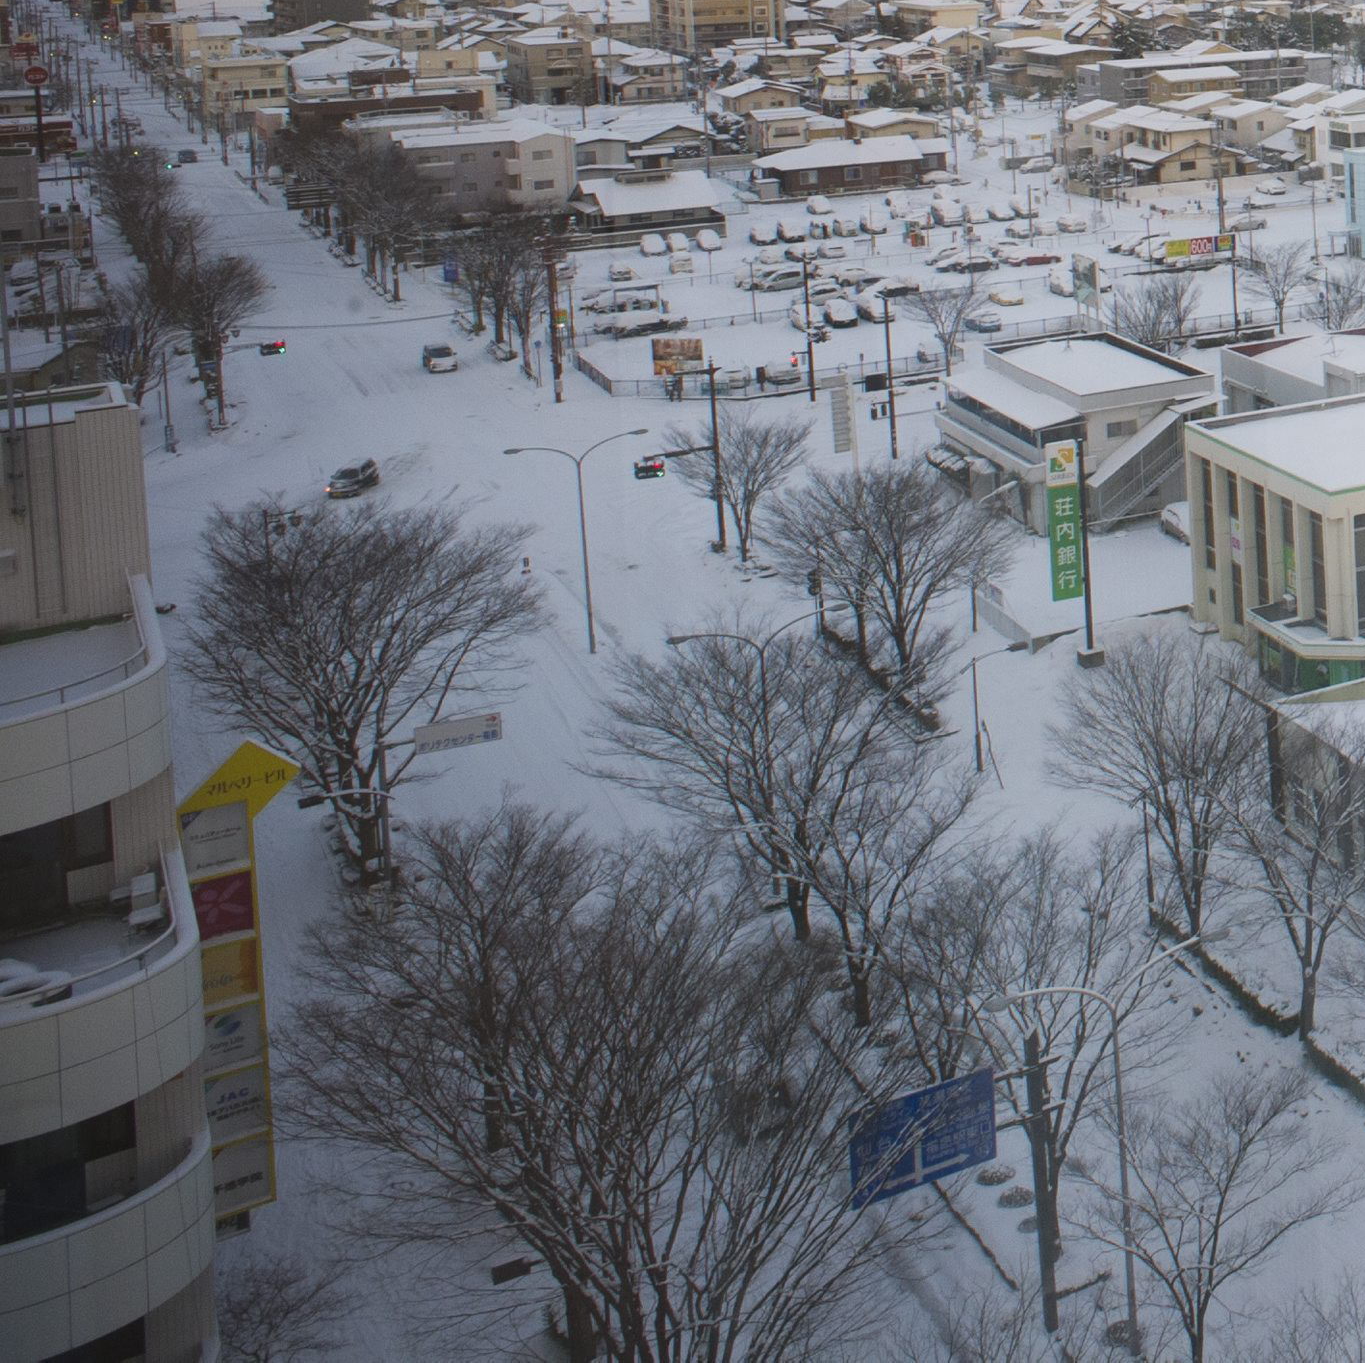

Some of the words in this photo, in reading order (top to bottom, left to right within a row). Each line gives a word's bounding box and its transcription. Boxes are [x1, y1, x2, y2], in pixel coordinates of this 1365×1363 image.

[1055, 497, 1077, 590] 荘内銀行
[216, 1087, 249, 1104] JAC
